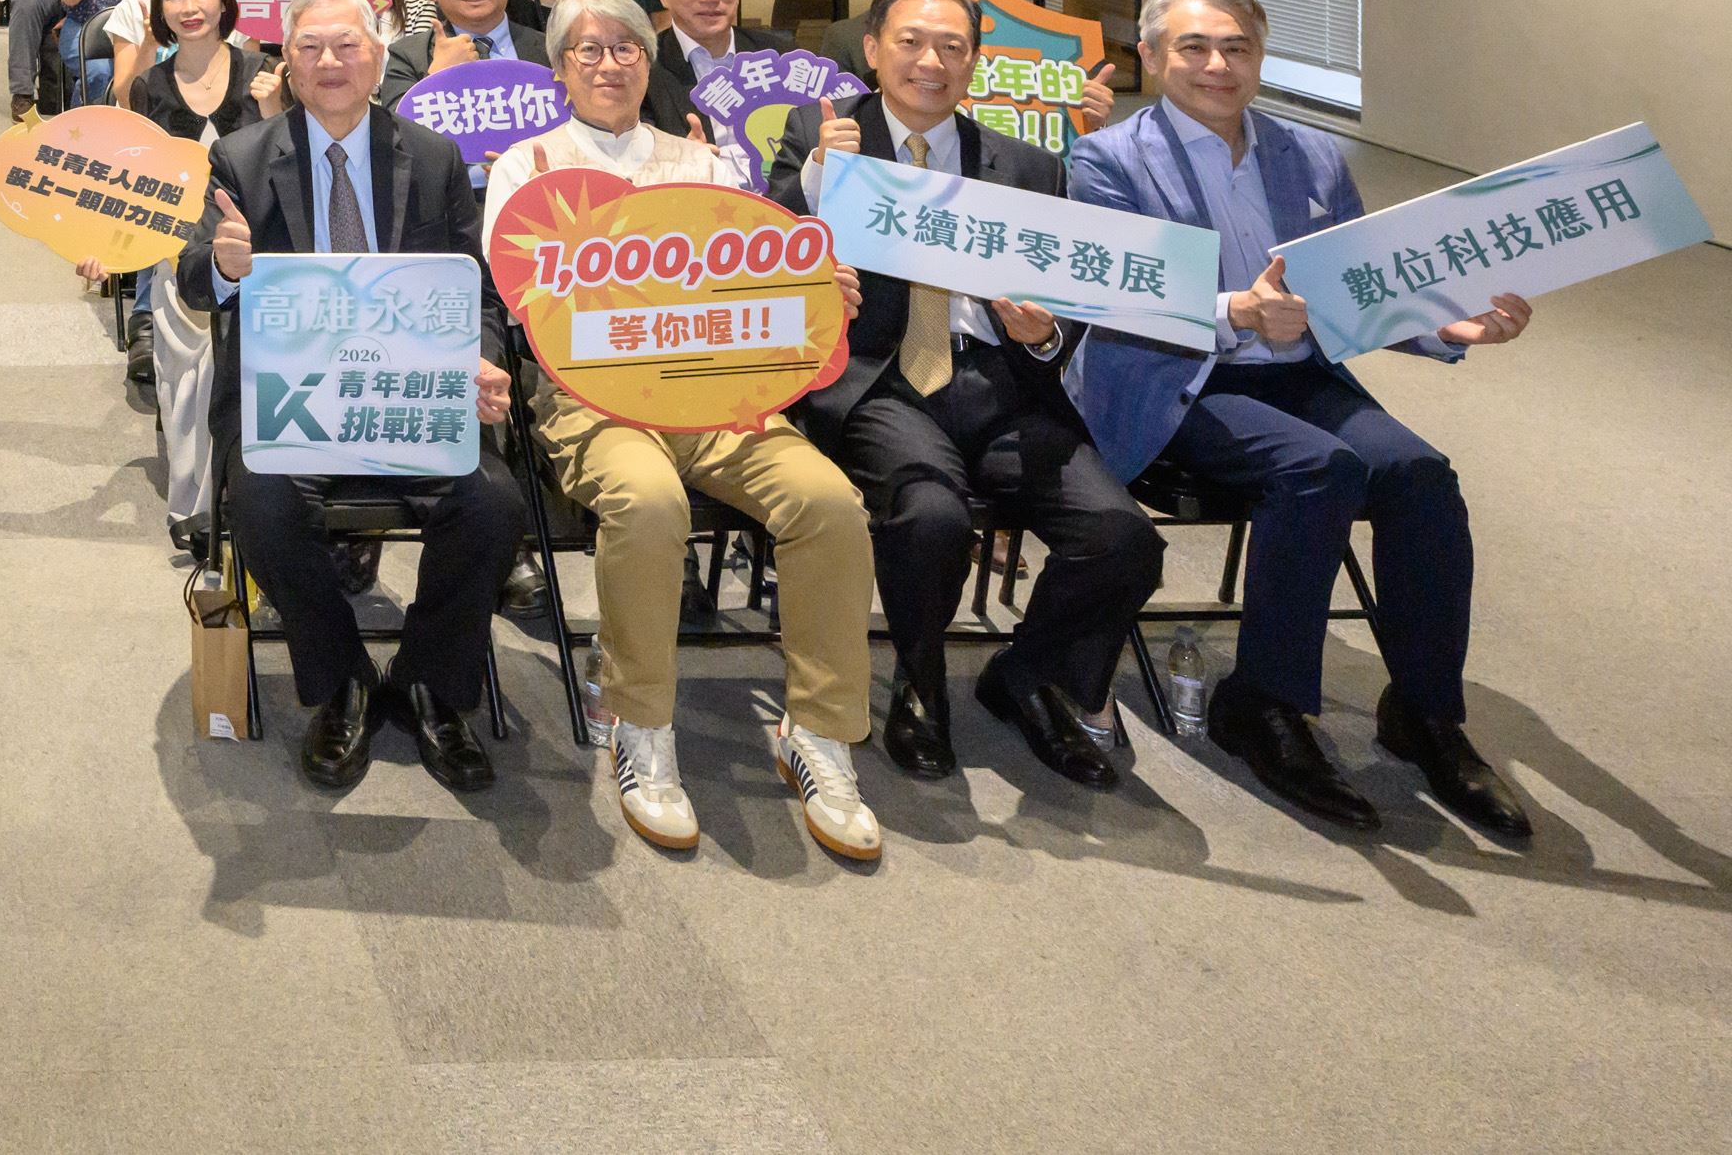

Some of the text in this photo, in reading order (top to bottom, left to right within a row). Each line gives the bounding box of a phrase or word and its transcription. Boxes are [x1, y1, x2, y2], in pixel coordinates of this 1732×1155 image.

[411, 83, 560, 136] 我挺你
[34, 144, 185, 206] 幫青年人的船
[536, 224, 825, 294] 1,000,000
[865, 194, 1167, 300] 永續淨零發展
[1340, 178, 1643, 311] 數位科技應用
[249, 285, 474, 335] 高雄永續
[608, 306, 771, 351] 等你喔!!
[339, 349, 381, 363] 2026
[337, 369, 469, 400] 青年創業
[336, 405, 468, 445] 挑戰賽
